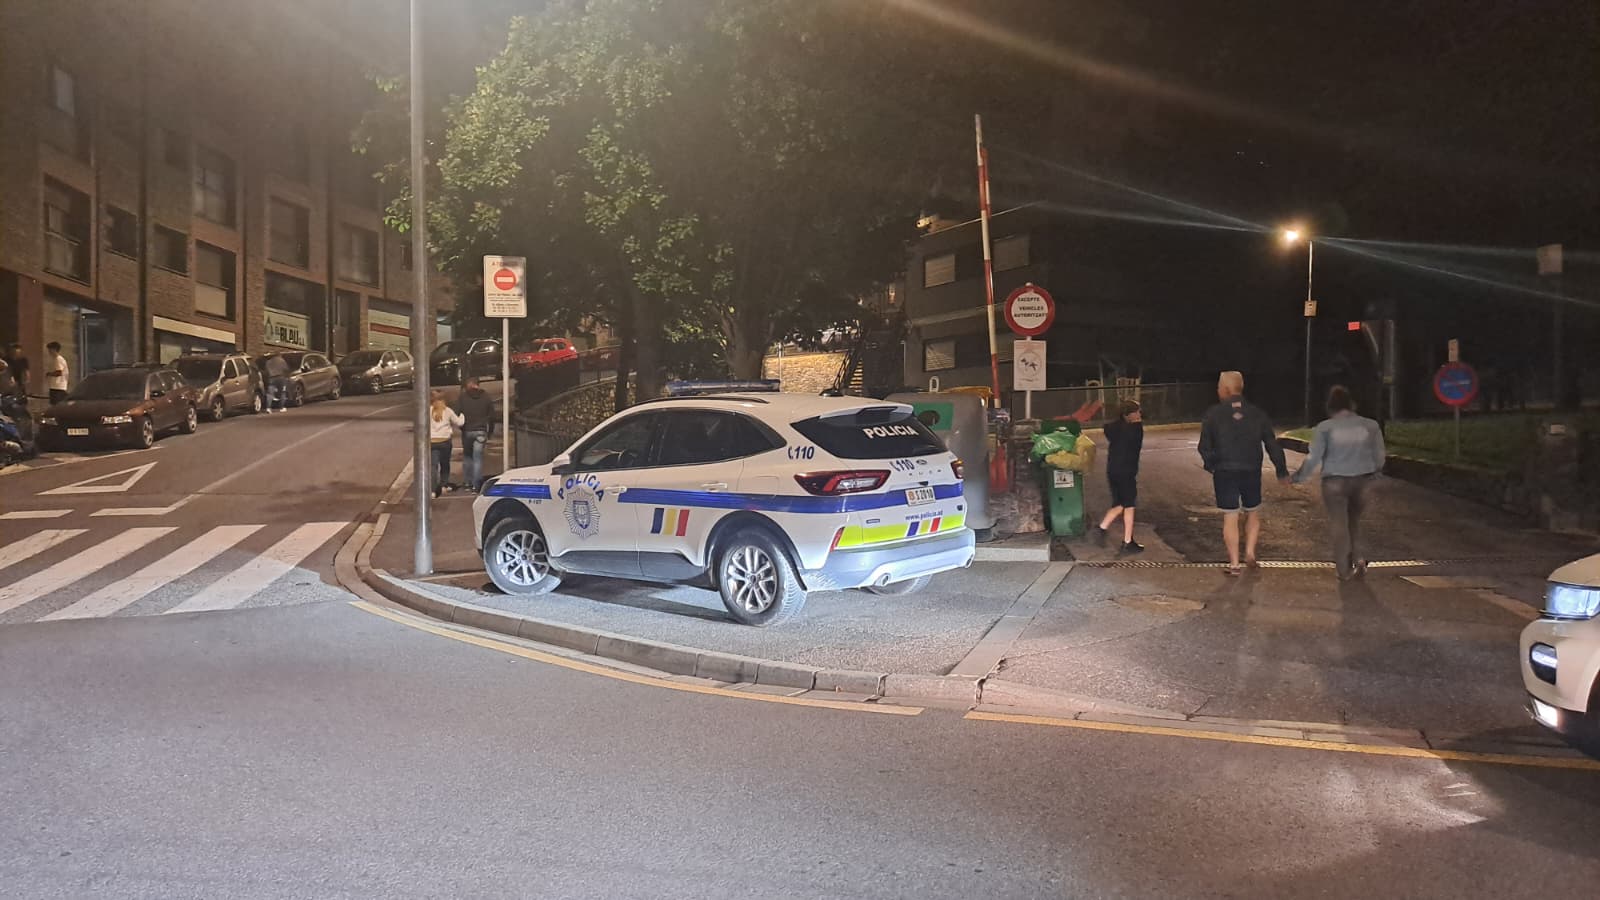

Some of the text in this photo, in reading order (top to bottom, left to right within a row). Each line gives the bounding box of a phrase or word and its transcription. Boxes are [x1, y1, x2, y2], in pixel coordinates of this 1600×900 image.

[280, 327, 298, 344] BLAU
[863, 425, 919, 438] POLICIA
[795, 446, 815, 460] 110
[896, 459, 916, 472] 110
[557, 474, 604, 502] POLICIA
